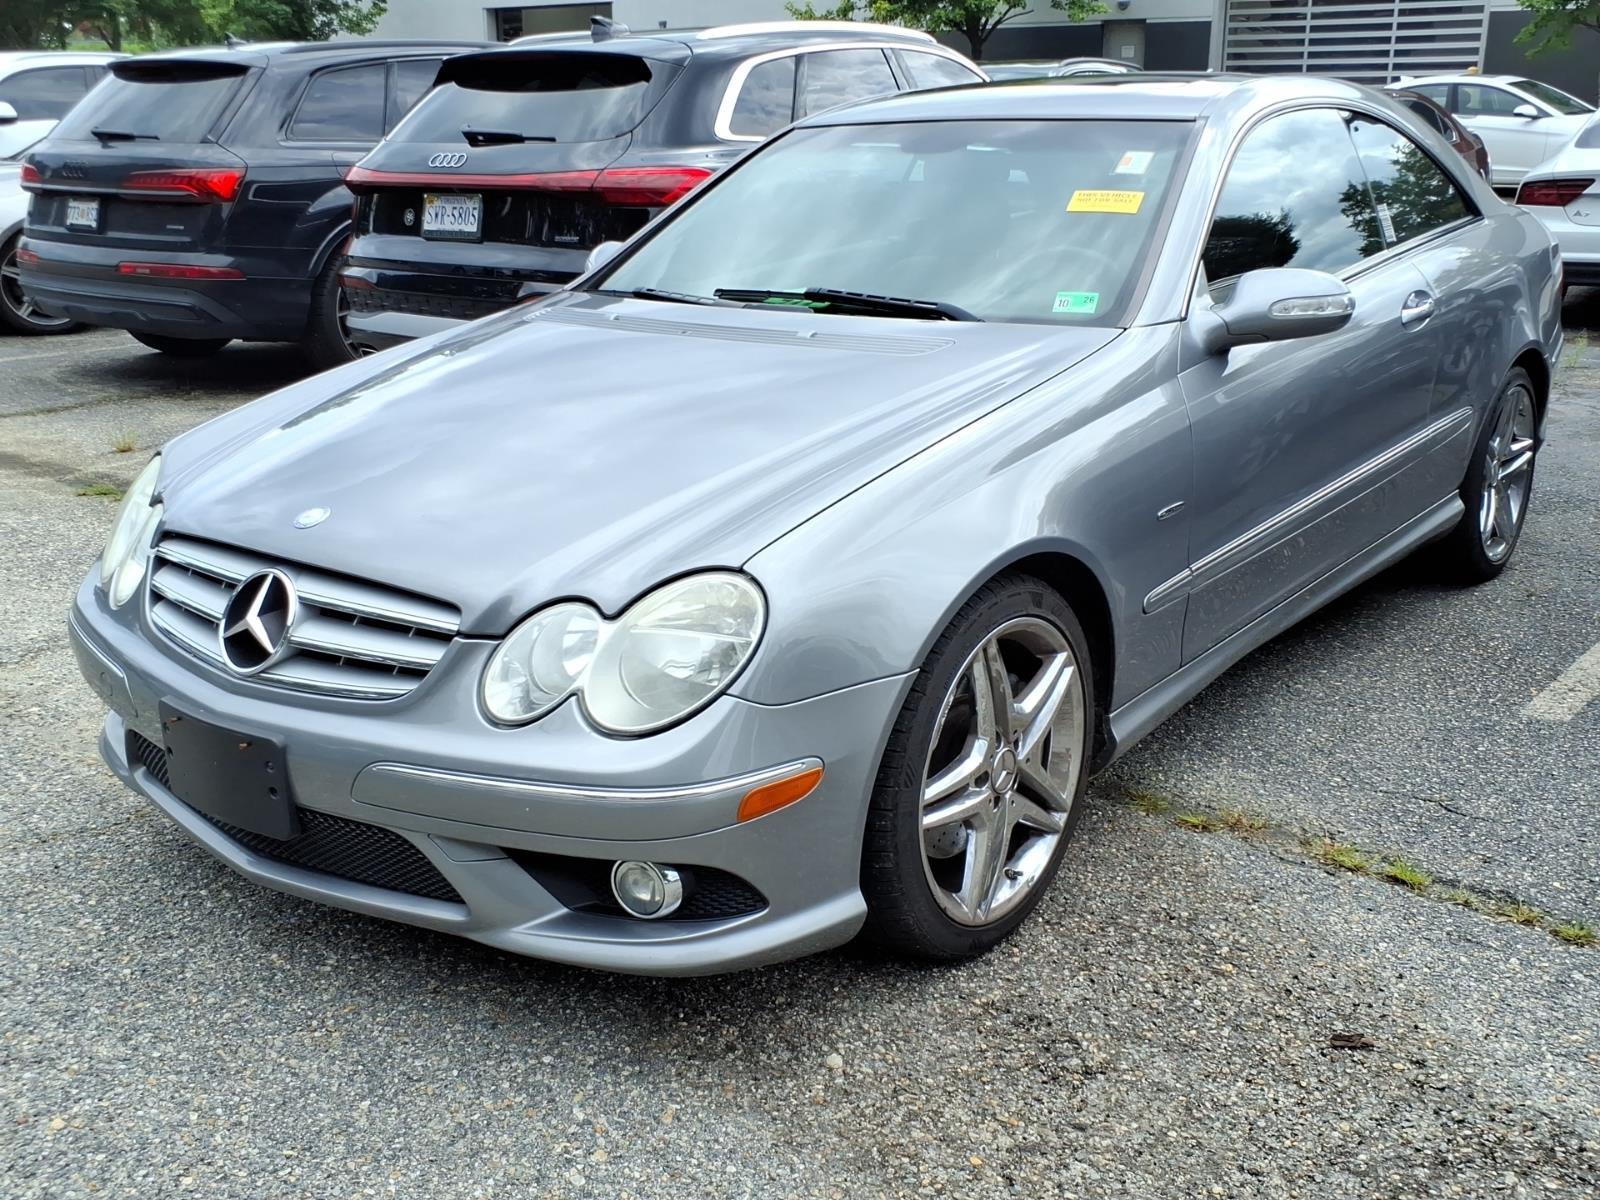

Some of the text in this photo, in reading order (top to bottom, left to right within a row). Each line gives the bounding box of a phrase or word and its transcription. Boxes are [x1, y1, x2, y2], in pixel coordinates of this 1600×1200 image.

[426, 205, 477, 226] SWR-5805
[1057, 298, 1070, 308] 10
[1083, 296, 1096, 304] 26
